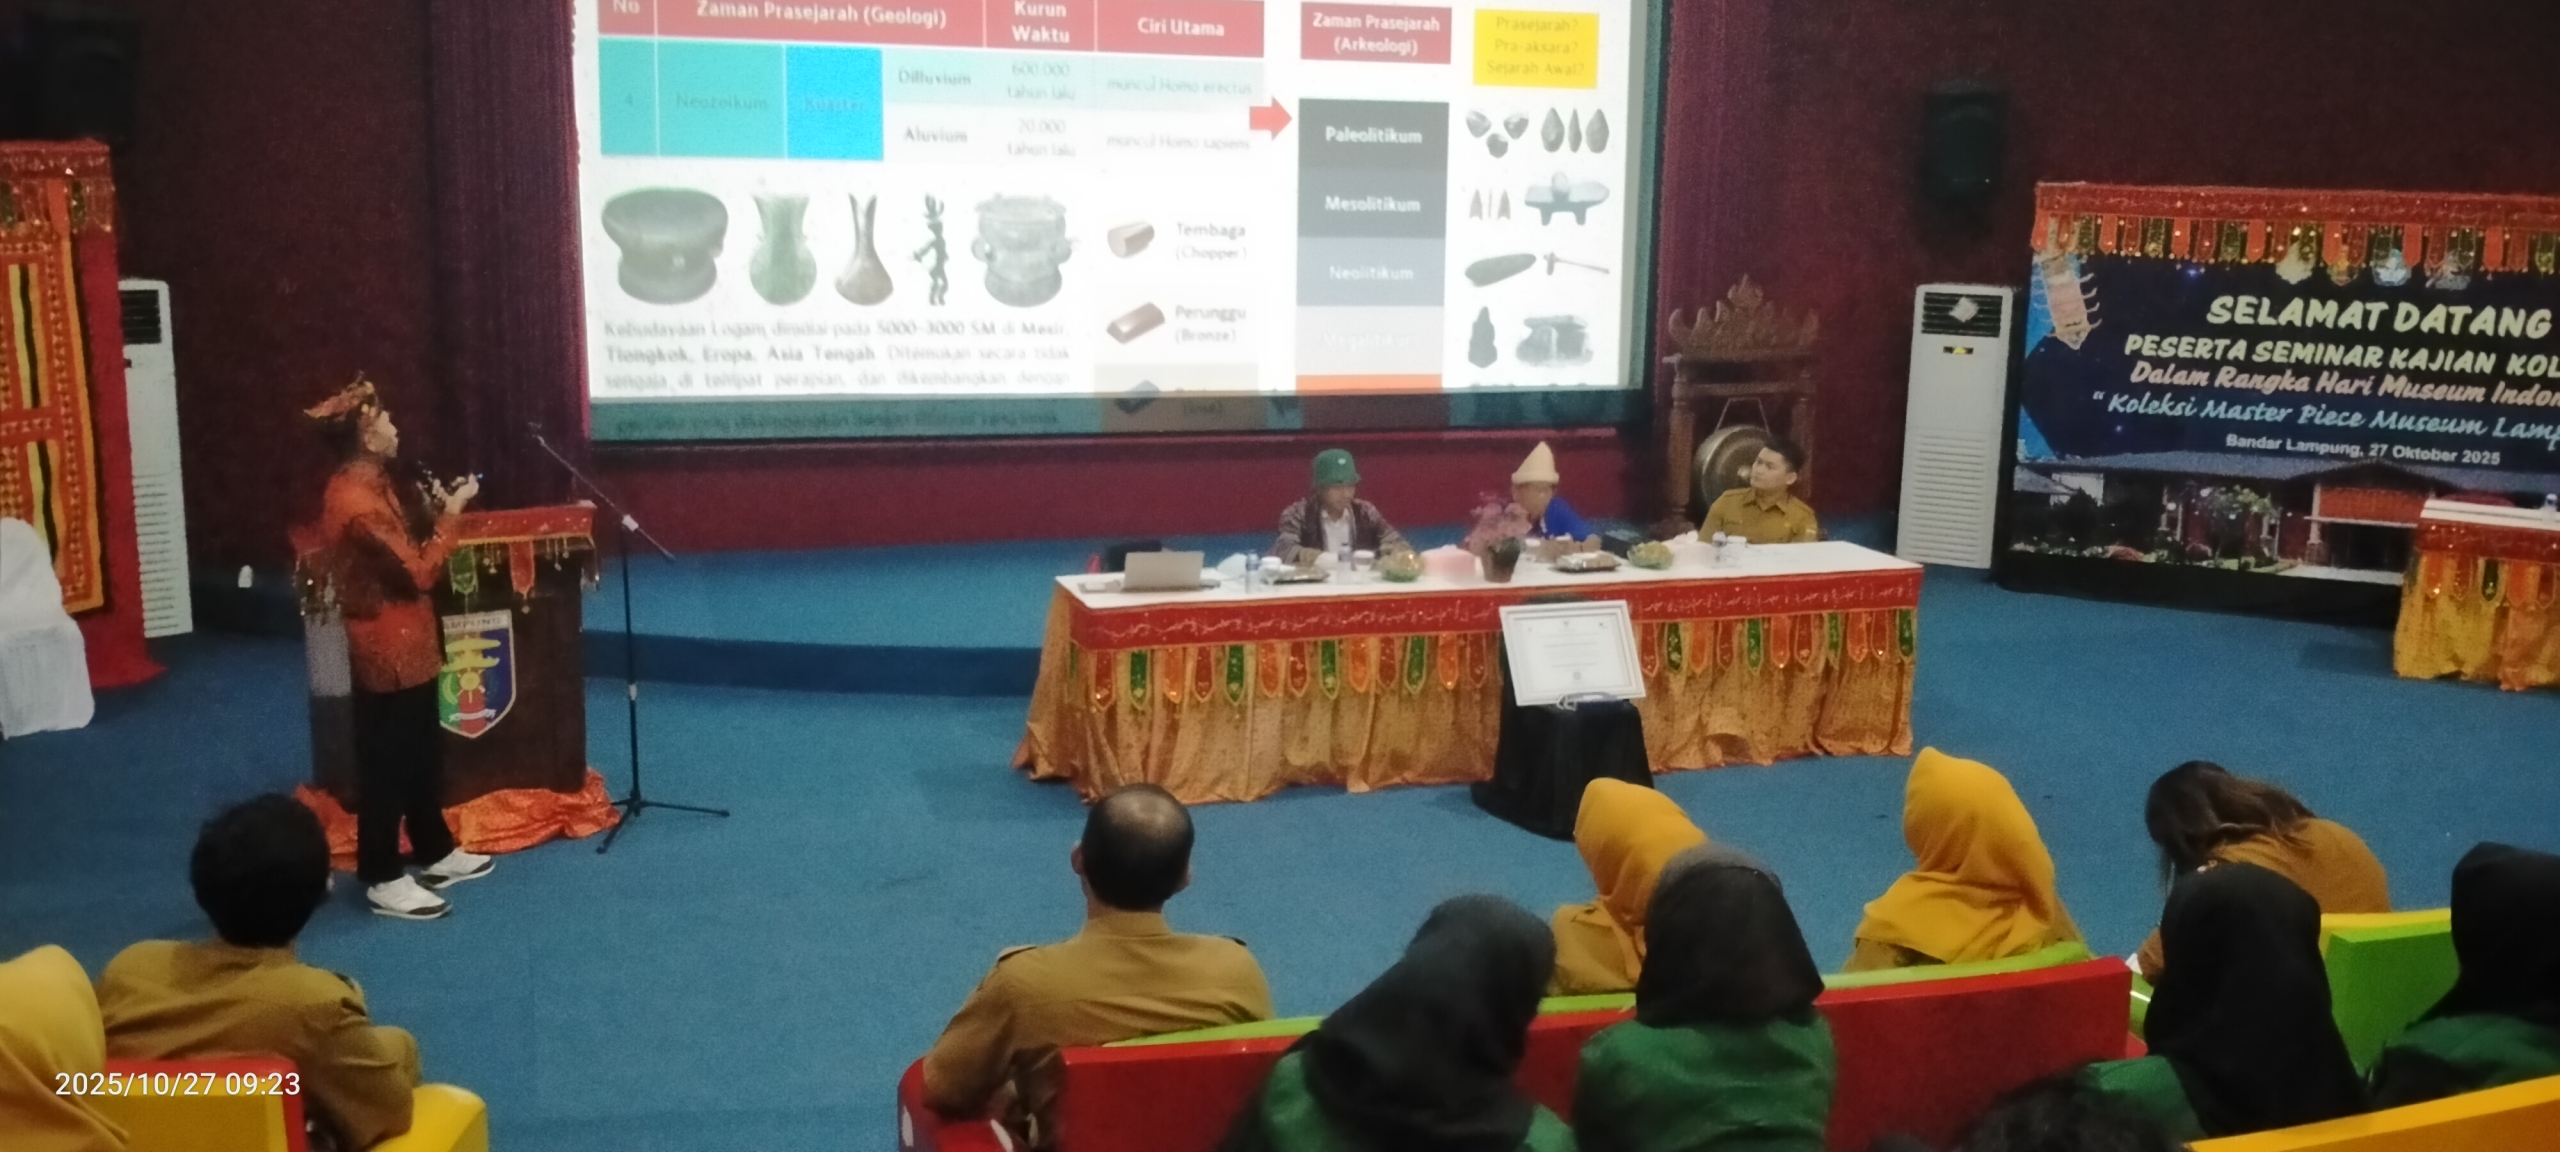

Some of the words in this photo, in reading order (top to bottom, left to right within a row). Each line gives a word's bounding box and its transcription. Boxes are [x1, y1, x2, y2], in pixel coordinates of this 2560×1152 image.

[697, 1, 758, 18] Zaman
[764, 1, 857, 25] Prasejarah
[863, 6, 947, 30] (Geologi)
[1014, 0, 1066, 18] Kurun
[1138, 17, 1168, 35] Ciri
[1170, 19, 1225, 38] Utama
[1313, 12, 1361, 30] Zaman
[1366, 15, 1440, 34] Prasejarah
[1496, 16, 1579, 33] Prasejarah?
[1012, 24, 1070, 44] Waktu
[1334, 36, 1418, 57] (Arkeologi)
[1494, 38, 1579, 55] Pra-aksara?
[1487, 60, 1539, 77] Sejarah
[1545, 61, 1585, 77] Awal?
[897, 69, 973, 88] Dilluvium
[1106, 76, 1156, 93] muncul
[1159, 78, 1199, 94] Homo
[1203, 80, 1253, 97] erectus
[1007, 84, 1048, 101] tahun
[1051, 85, 1076, 102] lalu
[903, 127, 969, 144] Aluvium
[1106, 134, 1156, 150] muncul
[1159, 134, 1198, 151] Homo
[1203, 137, 1251, 154] sapiens
[1325, 125, 1422, 145] Paleolitikum
[1007, 142, 1048, 159] tahun
[1051, 143, 1076, 160] lalu
[1325, 195, 1421, 213] Mesolitikum
[1176, 222, 1247, 240] Tembaga
[1329, 266, 1414, 282] Neolitikum
[1175, 305, 1247, 323] Perunggu
[2205, 294, 2390, 332] SELAMAT
[2393, 301, 2552, 339] DATANG
[1175, 329, 1236, 344] (Bronze)
[767, 345, 803, 361] Asia
[2123, 333, 2247, 362] PESERTA
[2252, 341, 2384, 370] SEMINAR
[2388, 347, 2496, 375] KAJIAN
[2129, 360, 2208, 388] Dalam
[2215, 367, 2310, 397] Rangka
[2316, 371, 2375, 396] Hari
[2378, 373, 2487, 403] Museum
[2200, 402, 2294, 425] Master
[2299, 404, 2366, 428] Piece
[2368, 410, 2489, 437] Museum
[2225, 433, 2282, 451] Bandar
[2286, 438, 2364, 458] Lampung,
[2369, 443, 2388, 457] 27
[2392, 444, 2458, 463] Oktober
[2461, 449, 2500, 465] 2025
